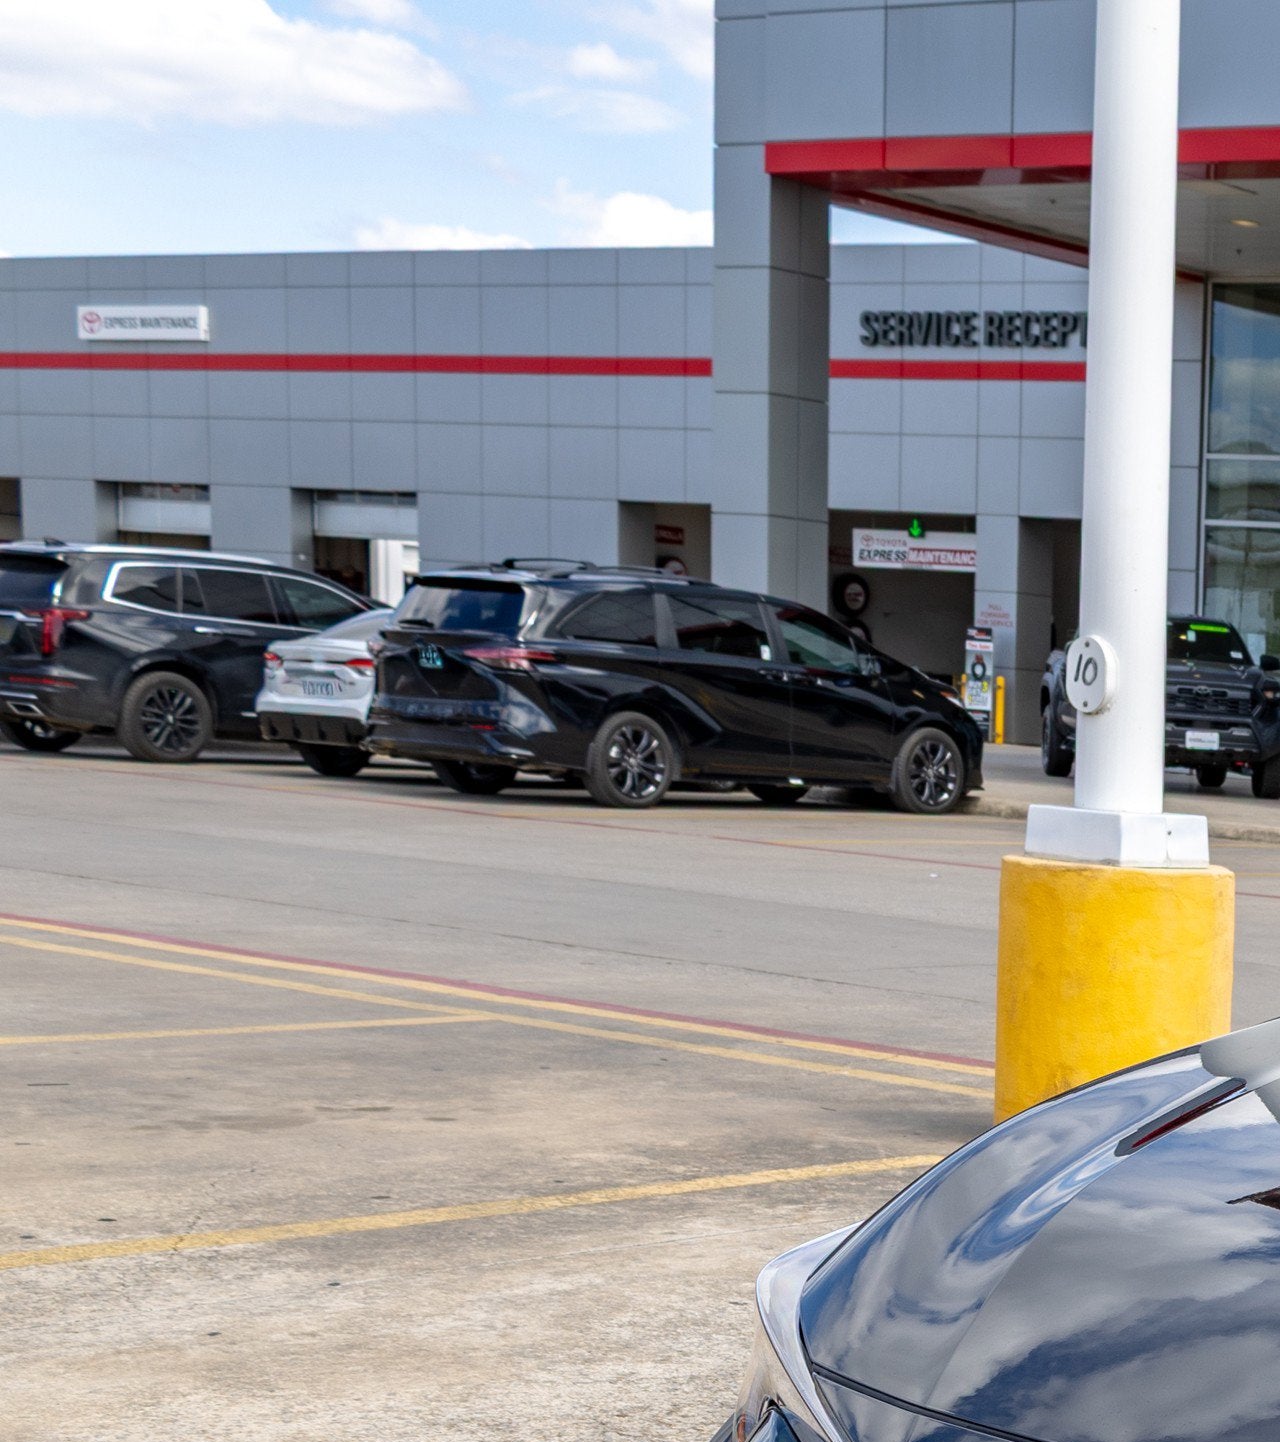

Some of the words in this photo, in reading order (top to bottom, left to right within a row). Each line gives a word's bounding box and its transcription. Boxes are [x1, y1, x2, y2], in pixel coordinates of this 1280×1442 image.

[104, 316, 138, 329] EXPRESS
[139, 316, 198, 329] MAINTENANCE
[860, 310, 980, 347] SERVICE
[873, 537, 907, 547] TOYOTA
[858, 548, 907, 562] EXPRESS
[1073, 653, 1099, 687] 10
